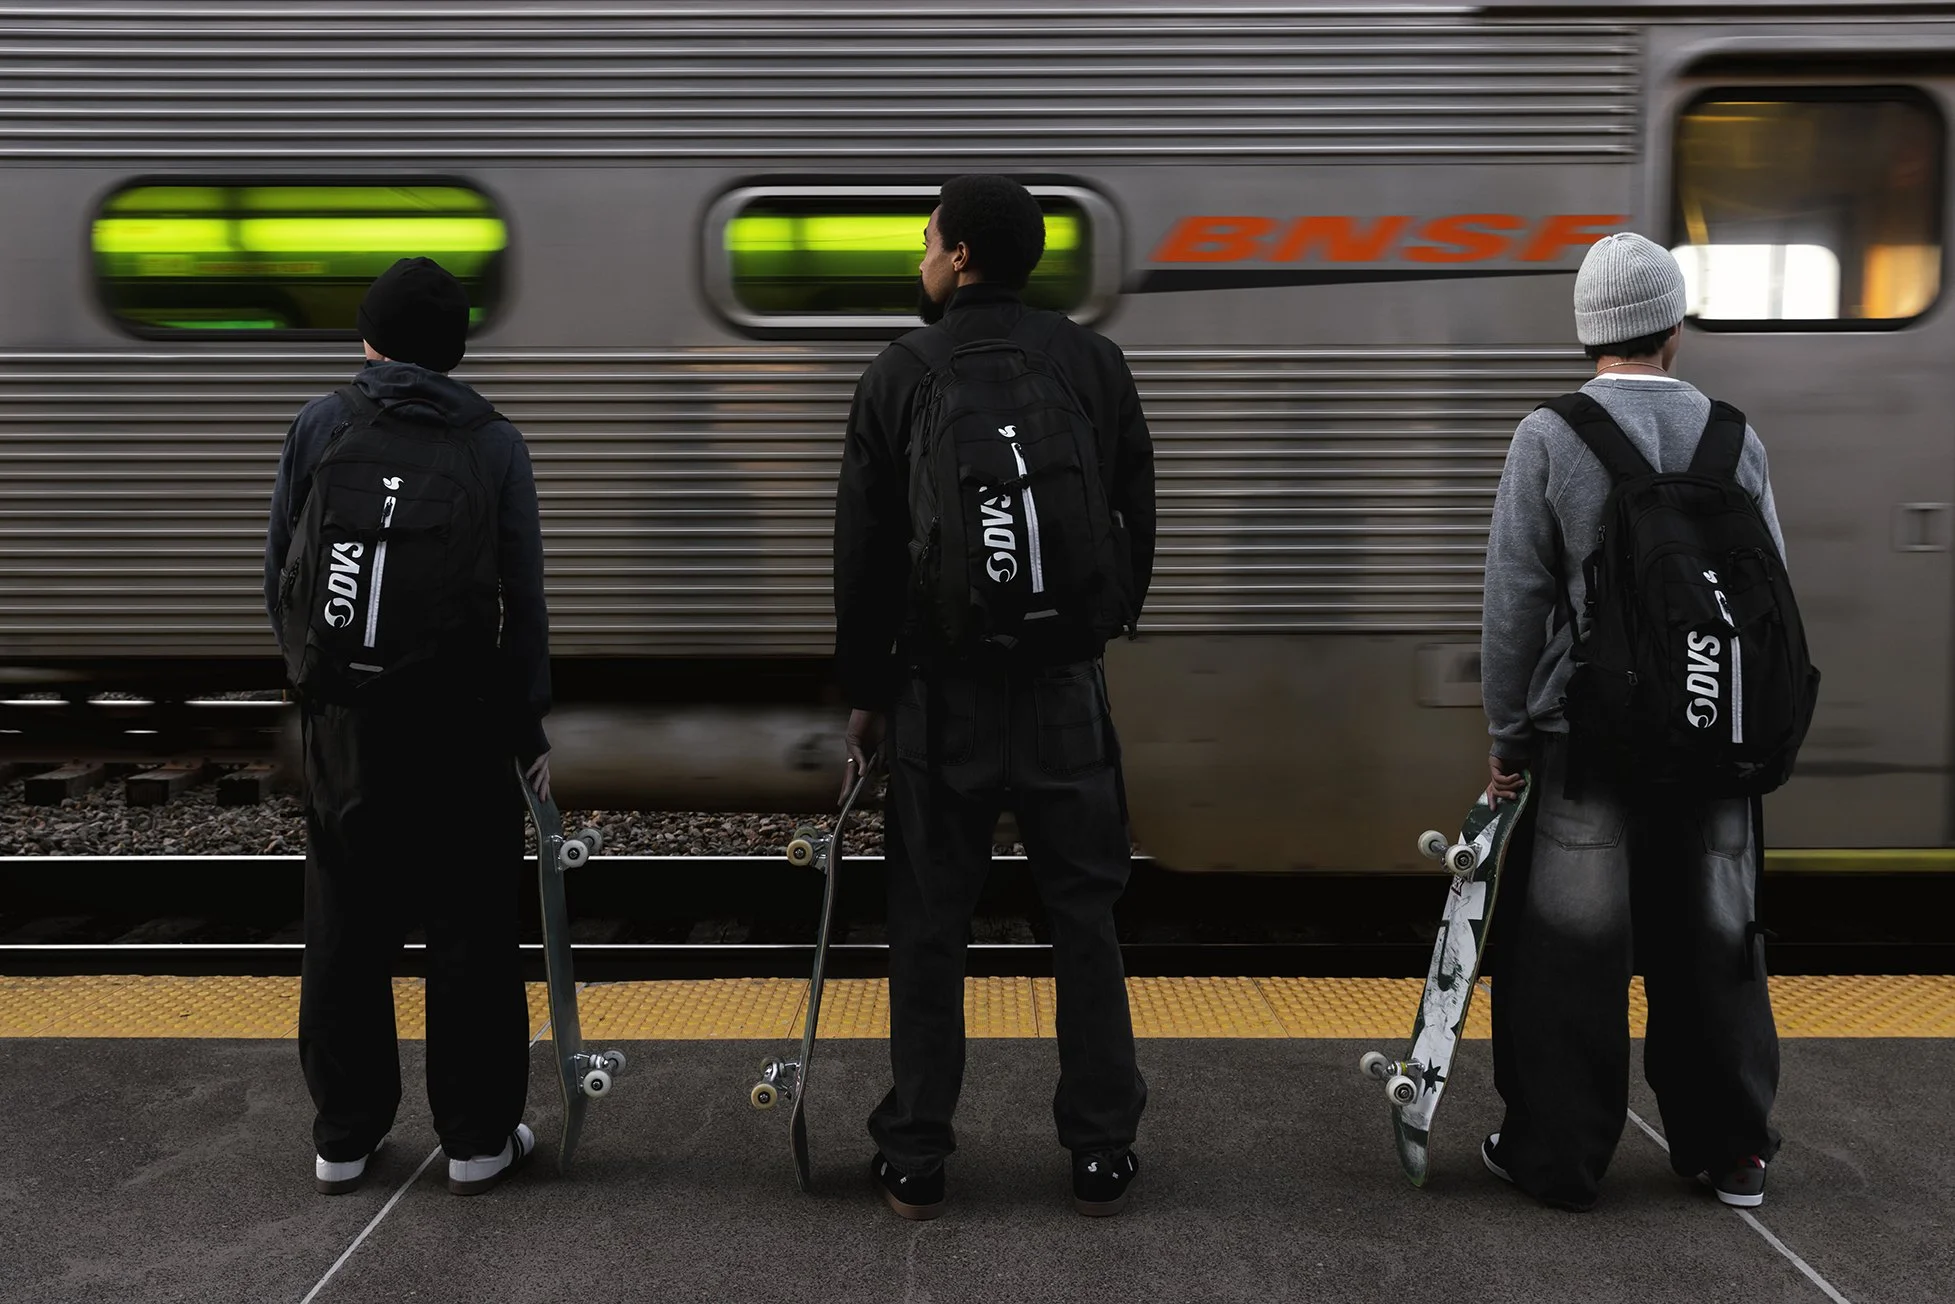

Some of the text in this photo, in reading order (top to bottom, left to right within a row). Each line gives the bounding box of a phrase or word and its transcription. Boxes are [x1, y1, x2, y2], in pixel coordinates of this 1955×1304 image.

[1151, 213, 1632, 264] BNSF
[327, 542, 365, 600] DVS
[1686, 630, 1721, 699] DVS
